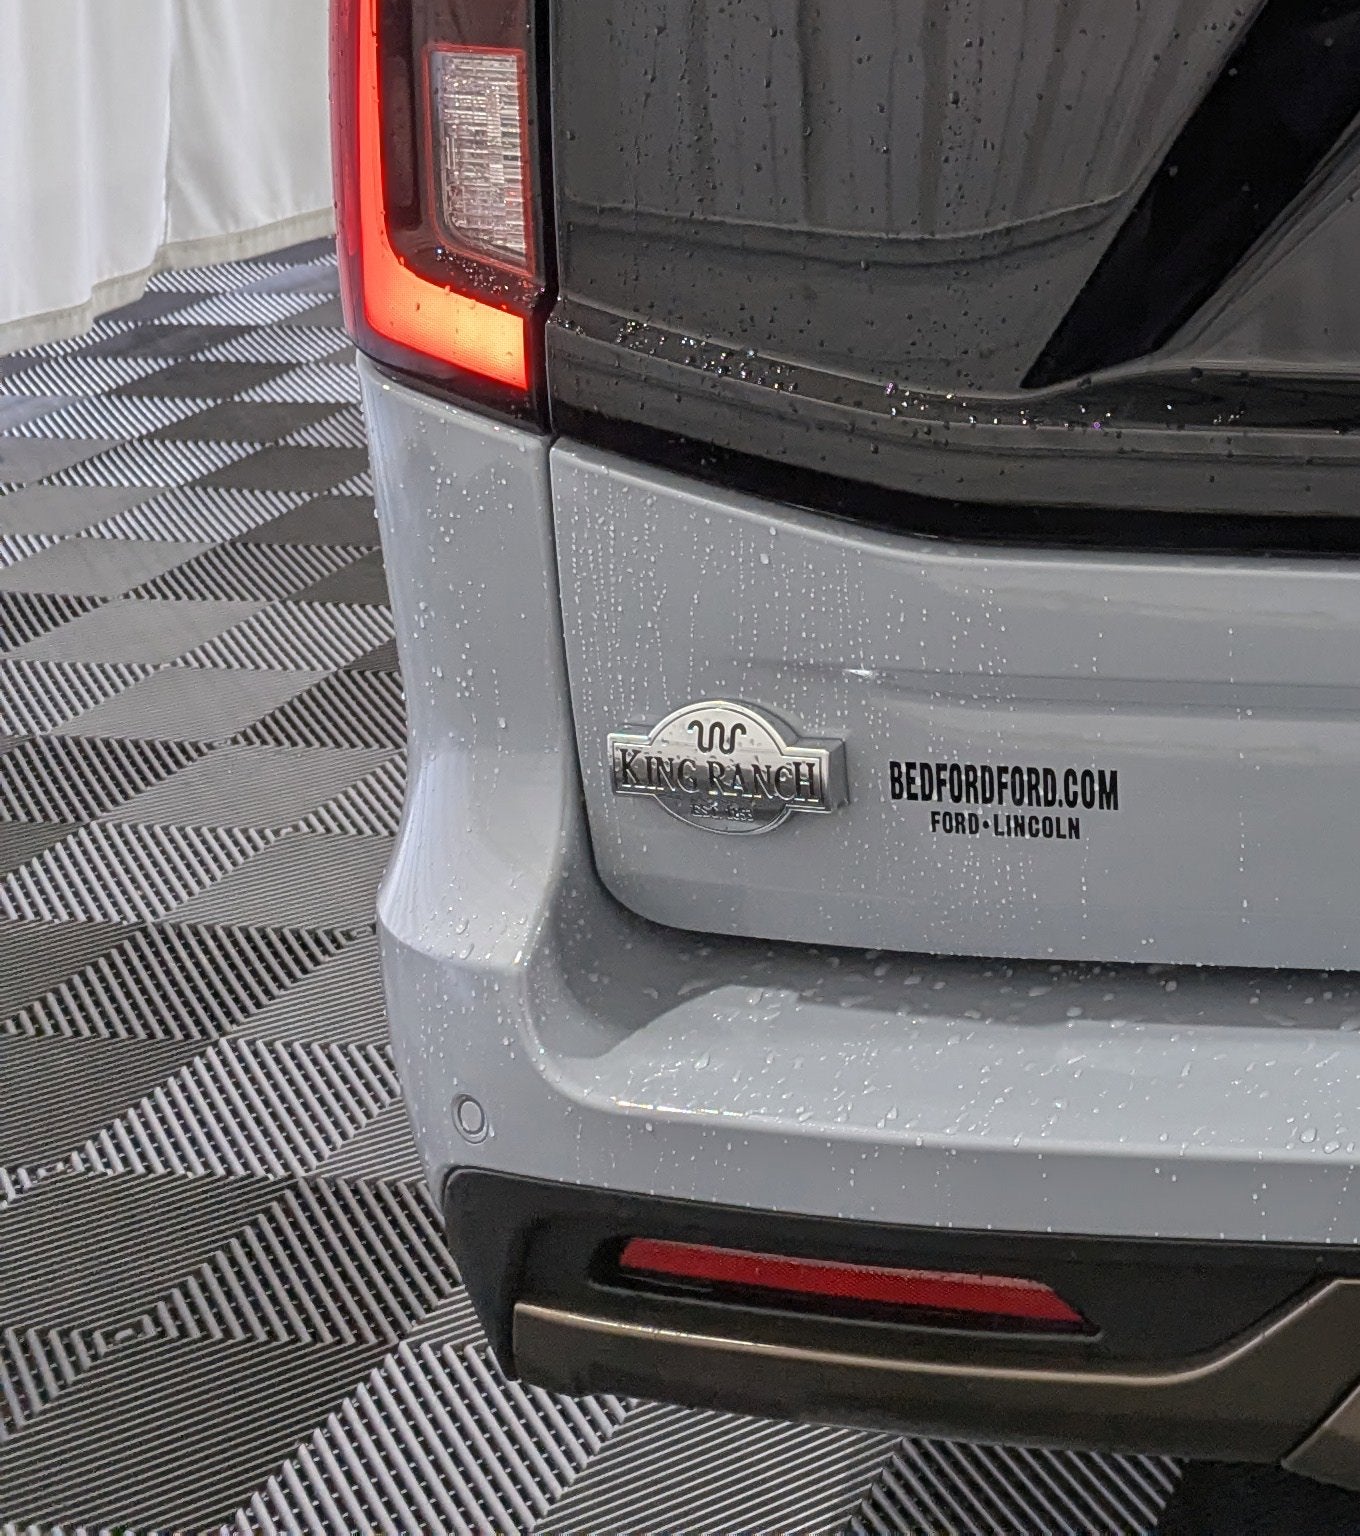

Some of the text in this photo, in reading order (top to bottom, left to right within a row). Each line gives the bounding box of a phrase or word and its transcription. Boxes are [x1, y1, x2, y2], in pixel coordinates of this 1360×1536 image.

[619, 748, 819, 802] KING RANCH
[889, 760, 1119, 811] BEDFORDFORD.COM
